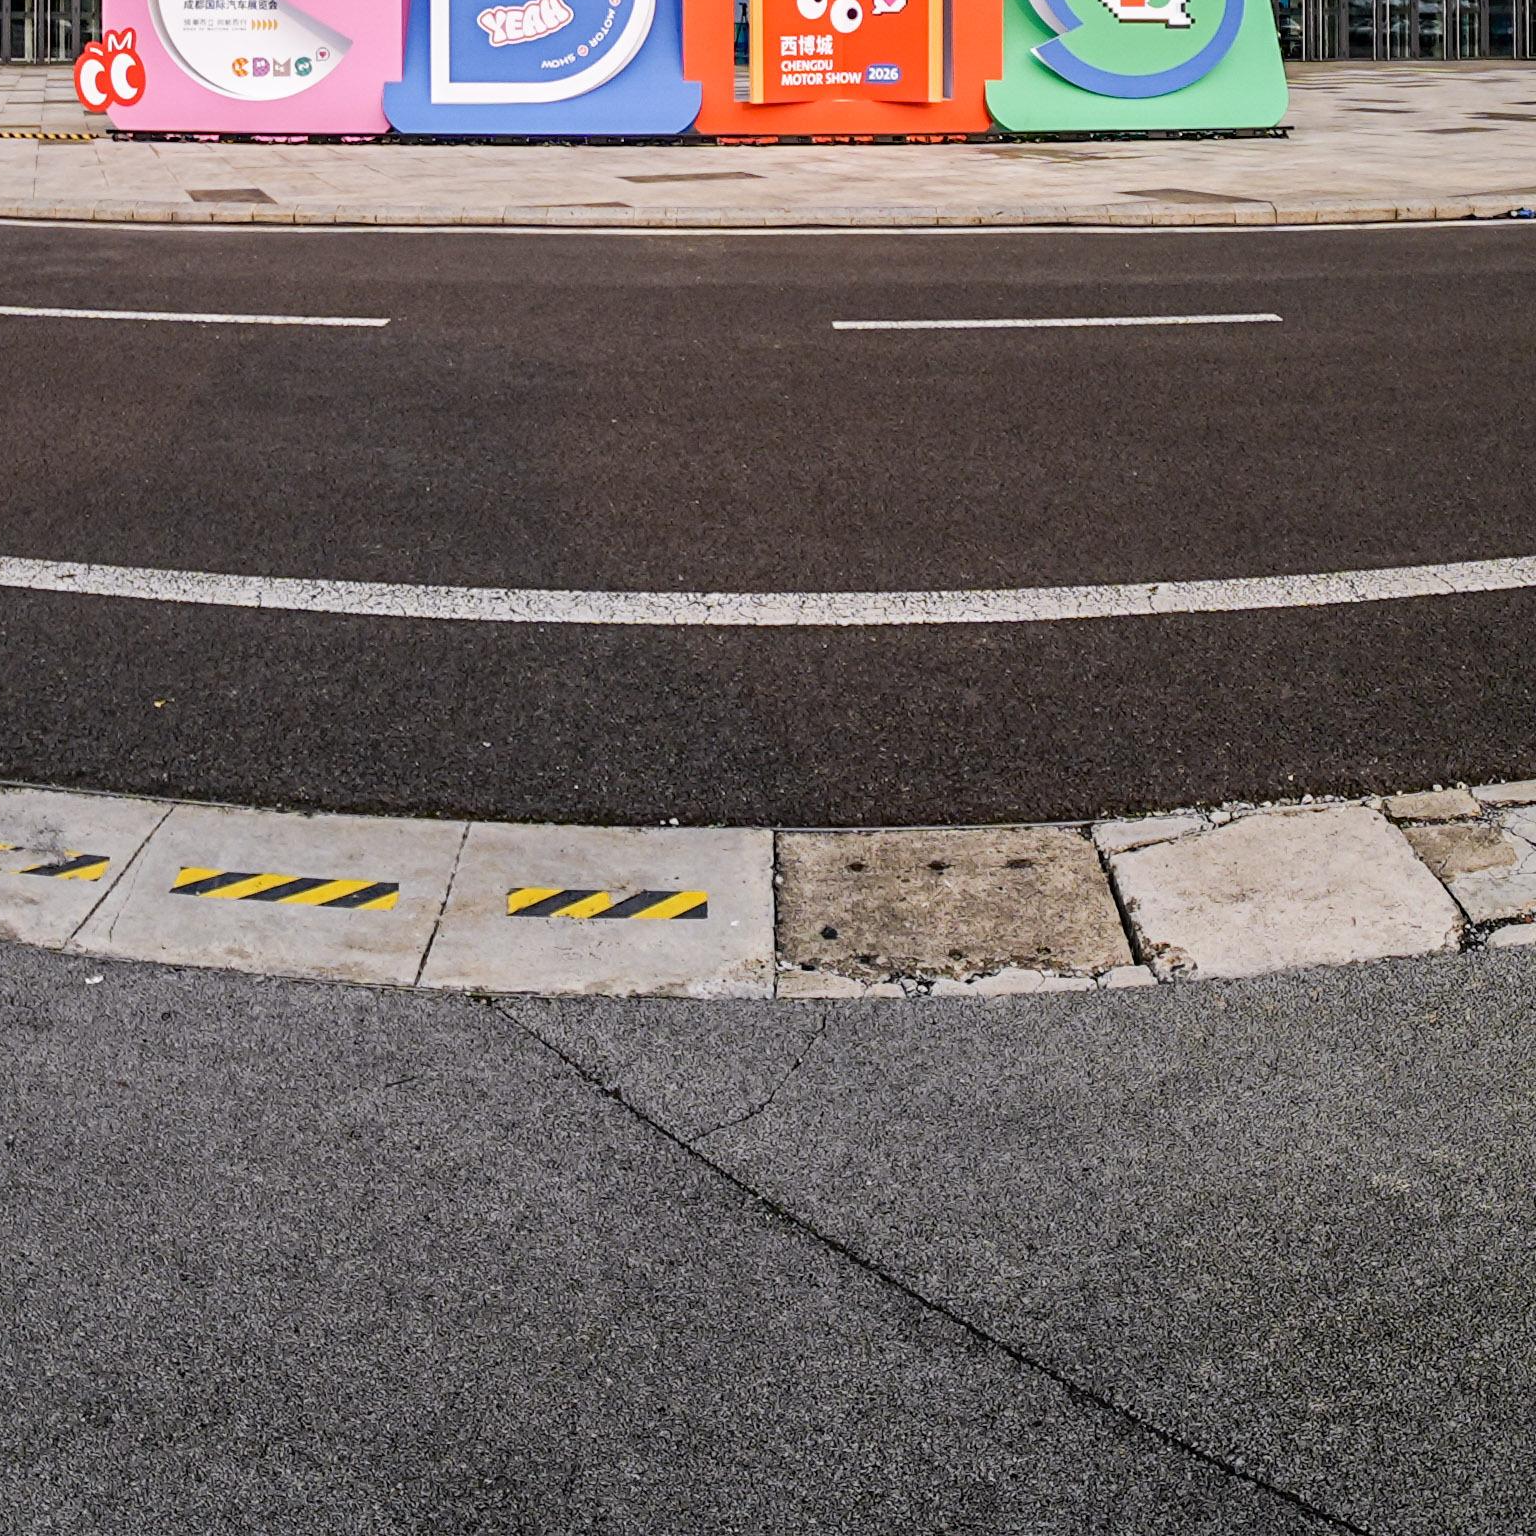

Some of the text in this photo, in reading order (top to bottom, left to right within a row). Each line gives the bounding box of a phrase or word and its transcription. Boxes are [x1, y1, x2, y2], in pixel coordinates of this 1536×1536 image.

[183, 0, 278, 10] 成都国际汽车展览会
[588, 8, 615, 48] MOTOR
[780, 34, 834, 56] 西博城
[540, 52, 577, 69] SHOW
[781, 59, 834, 72] CHENGDU
[781, 67, 899, 86] MOTOR SHOW 2026
